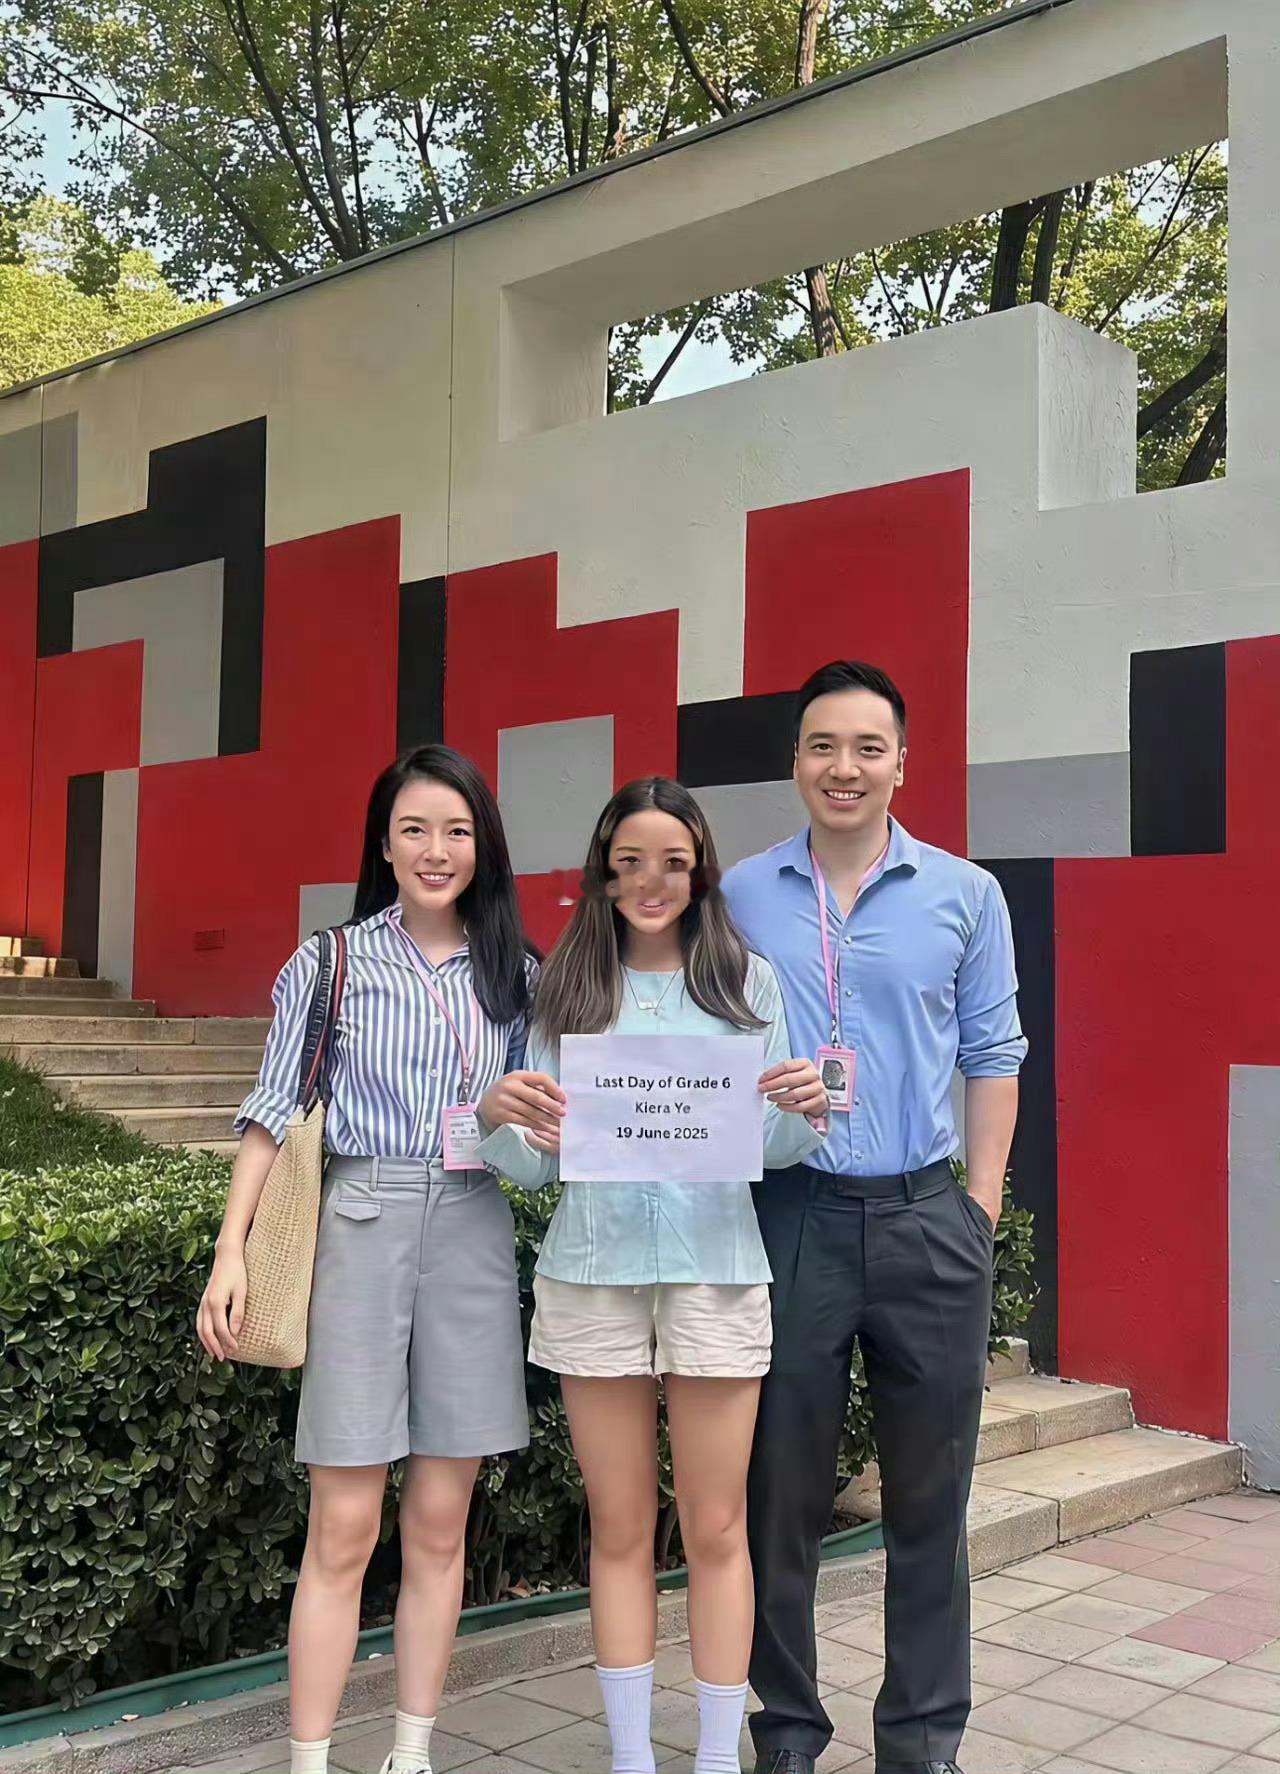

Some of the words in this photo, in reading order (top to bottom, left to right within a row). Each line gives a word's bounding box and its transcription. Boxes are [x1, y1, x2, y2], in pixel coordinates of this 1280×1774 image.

[595, 1076, 623, 1088] Last
[627, 1076, 655, 1092] Day
[658, 1075, 673, 1088] of
[676, 1076, 718, 1089] Grade
[721, 1076, 731, 1089] 6
[635, 1101, 671, 1114] Kiera
[674, 1102, 691, 1114] Ye
[616, 1126, 633, 1139] 19
[636, 1126, 670, 1140] June
[674, 1127, 709, 1140] 2025
